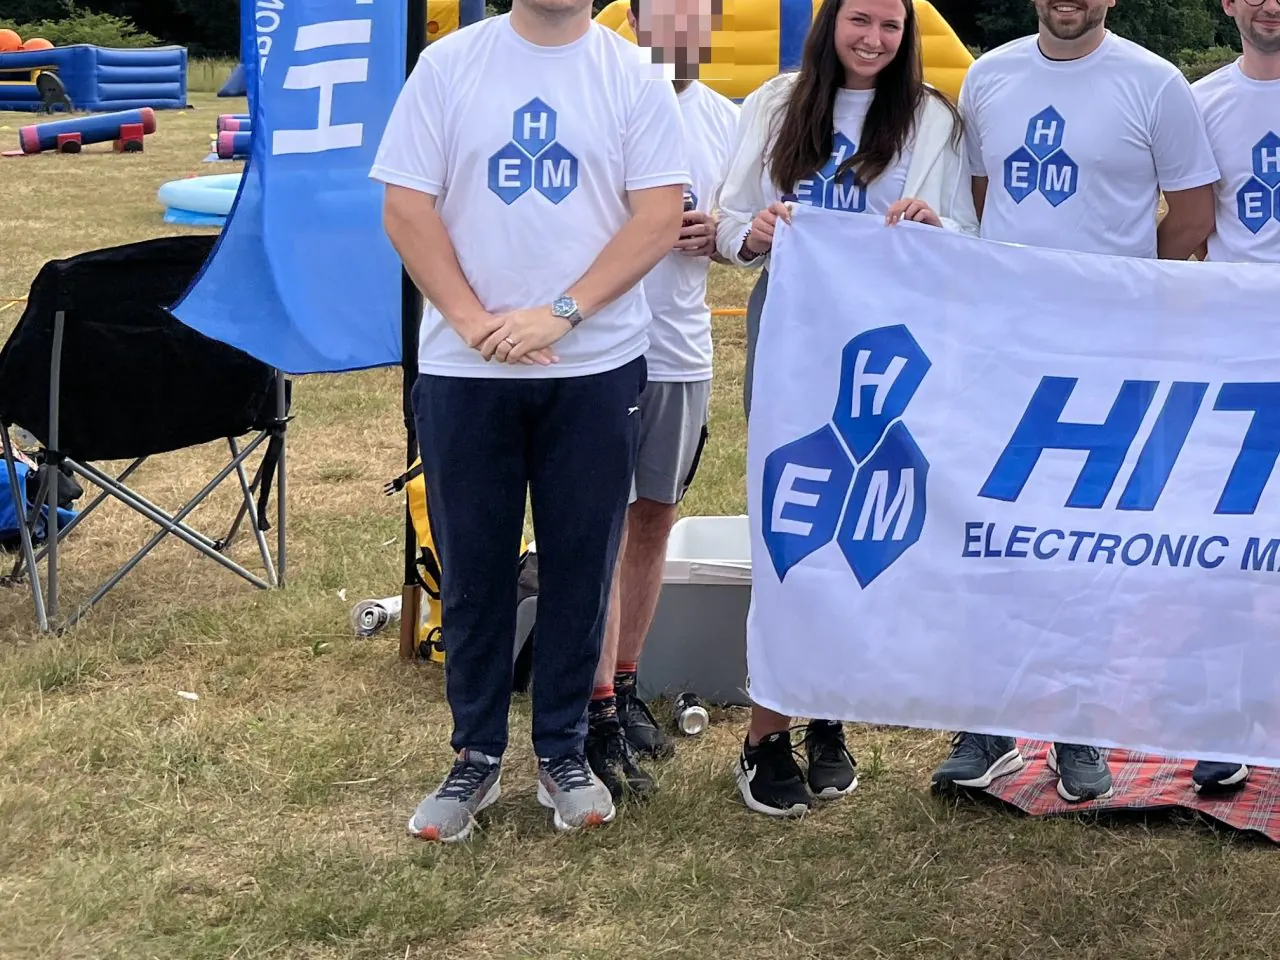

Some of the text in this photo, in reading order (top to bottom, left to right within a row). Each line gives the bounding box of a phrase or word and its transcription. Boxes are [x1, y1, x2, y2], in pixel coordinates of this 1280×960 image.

[523, 112, 548, 140] H
[1033, 119, 1057, 145] H
[850, 349, 908, 418] H
[961, 521, 1229, 569] ELECTRONIC
